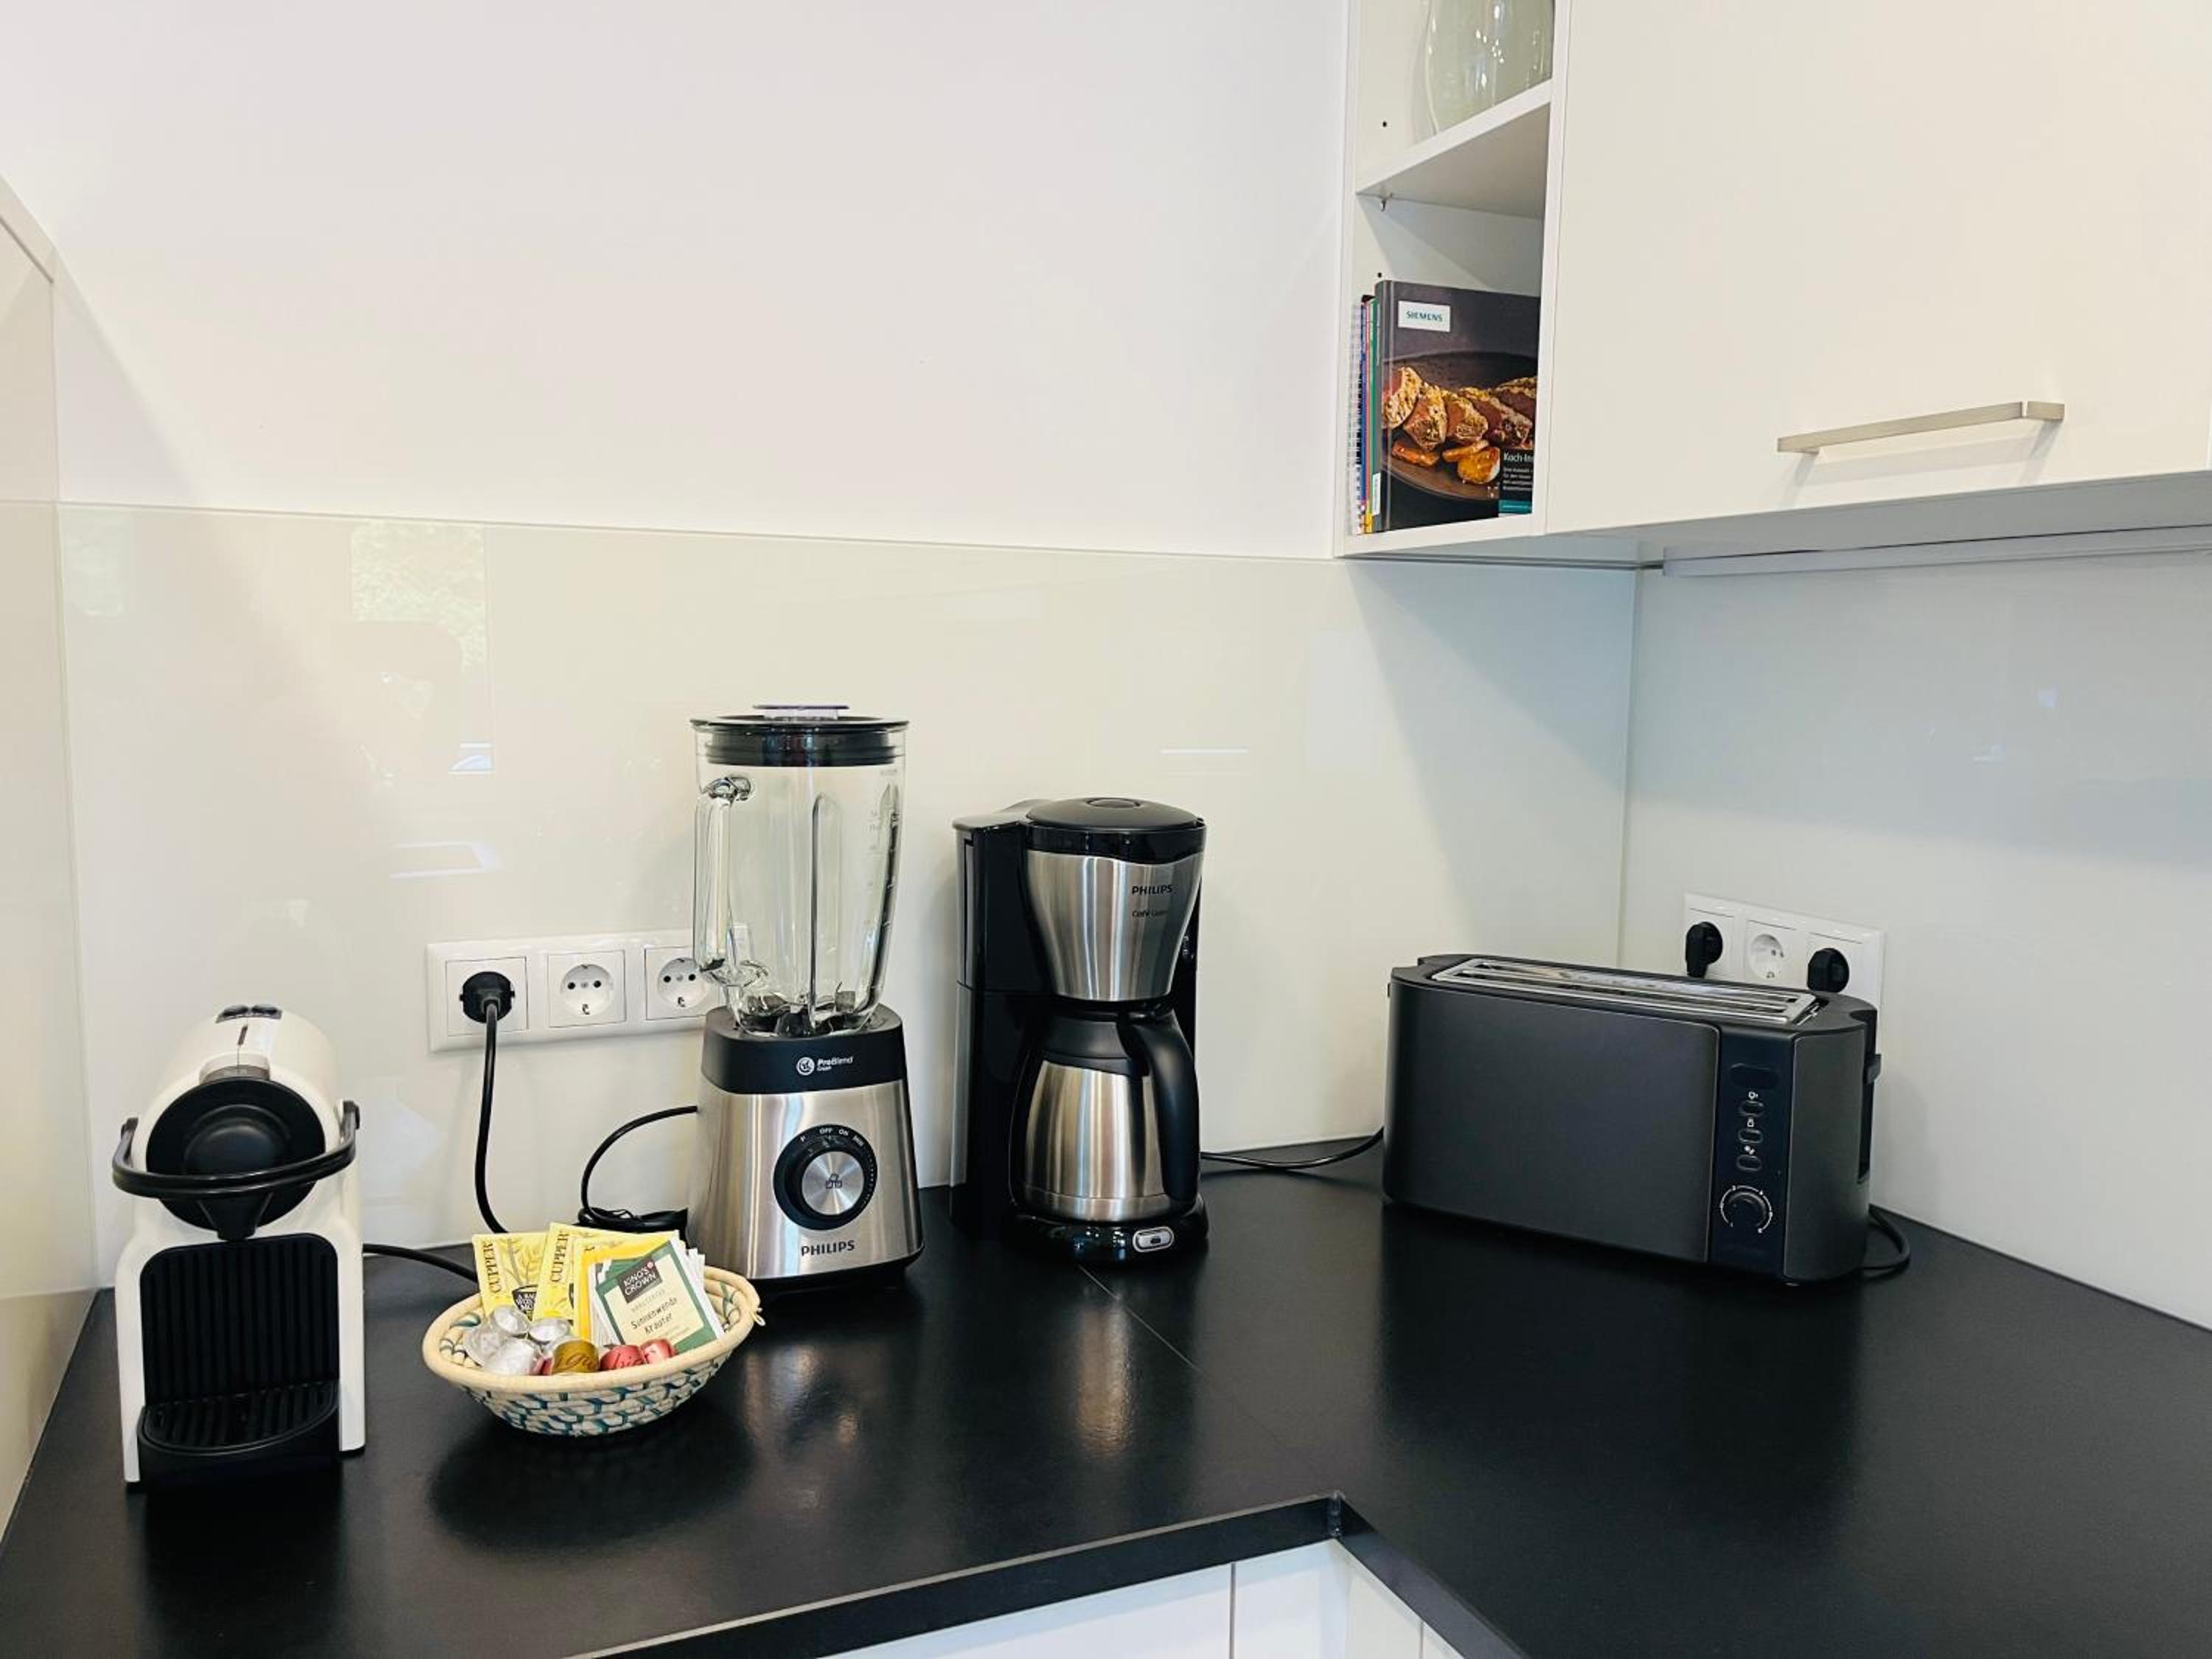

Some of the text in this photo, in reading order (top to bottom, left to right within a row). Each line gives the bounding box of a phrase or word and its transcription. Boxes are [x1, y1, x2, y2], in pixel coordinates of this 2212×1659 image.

[1406, 310, 1443, 322] SIEMENS
[1132, 885, 1173, 895] PHILIPS
[801, 1239, 855, 1256] PHILIPS
[624, 1272, 656, 1295] CROWN
